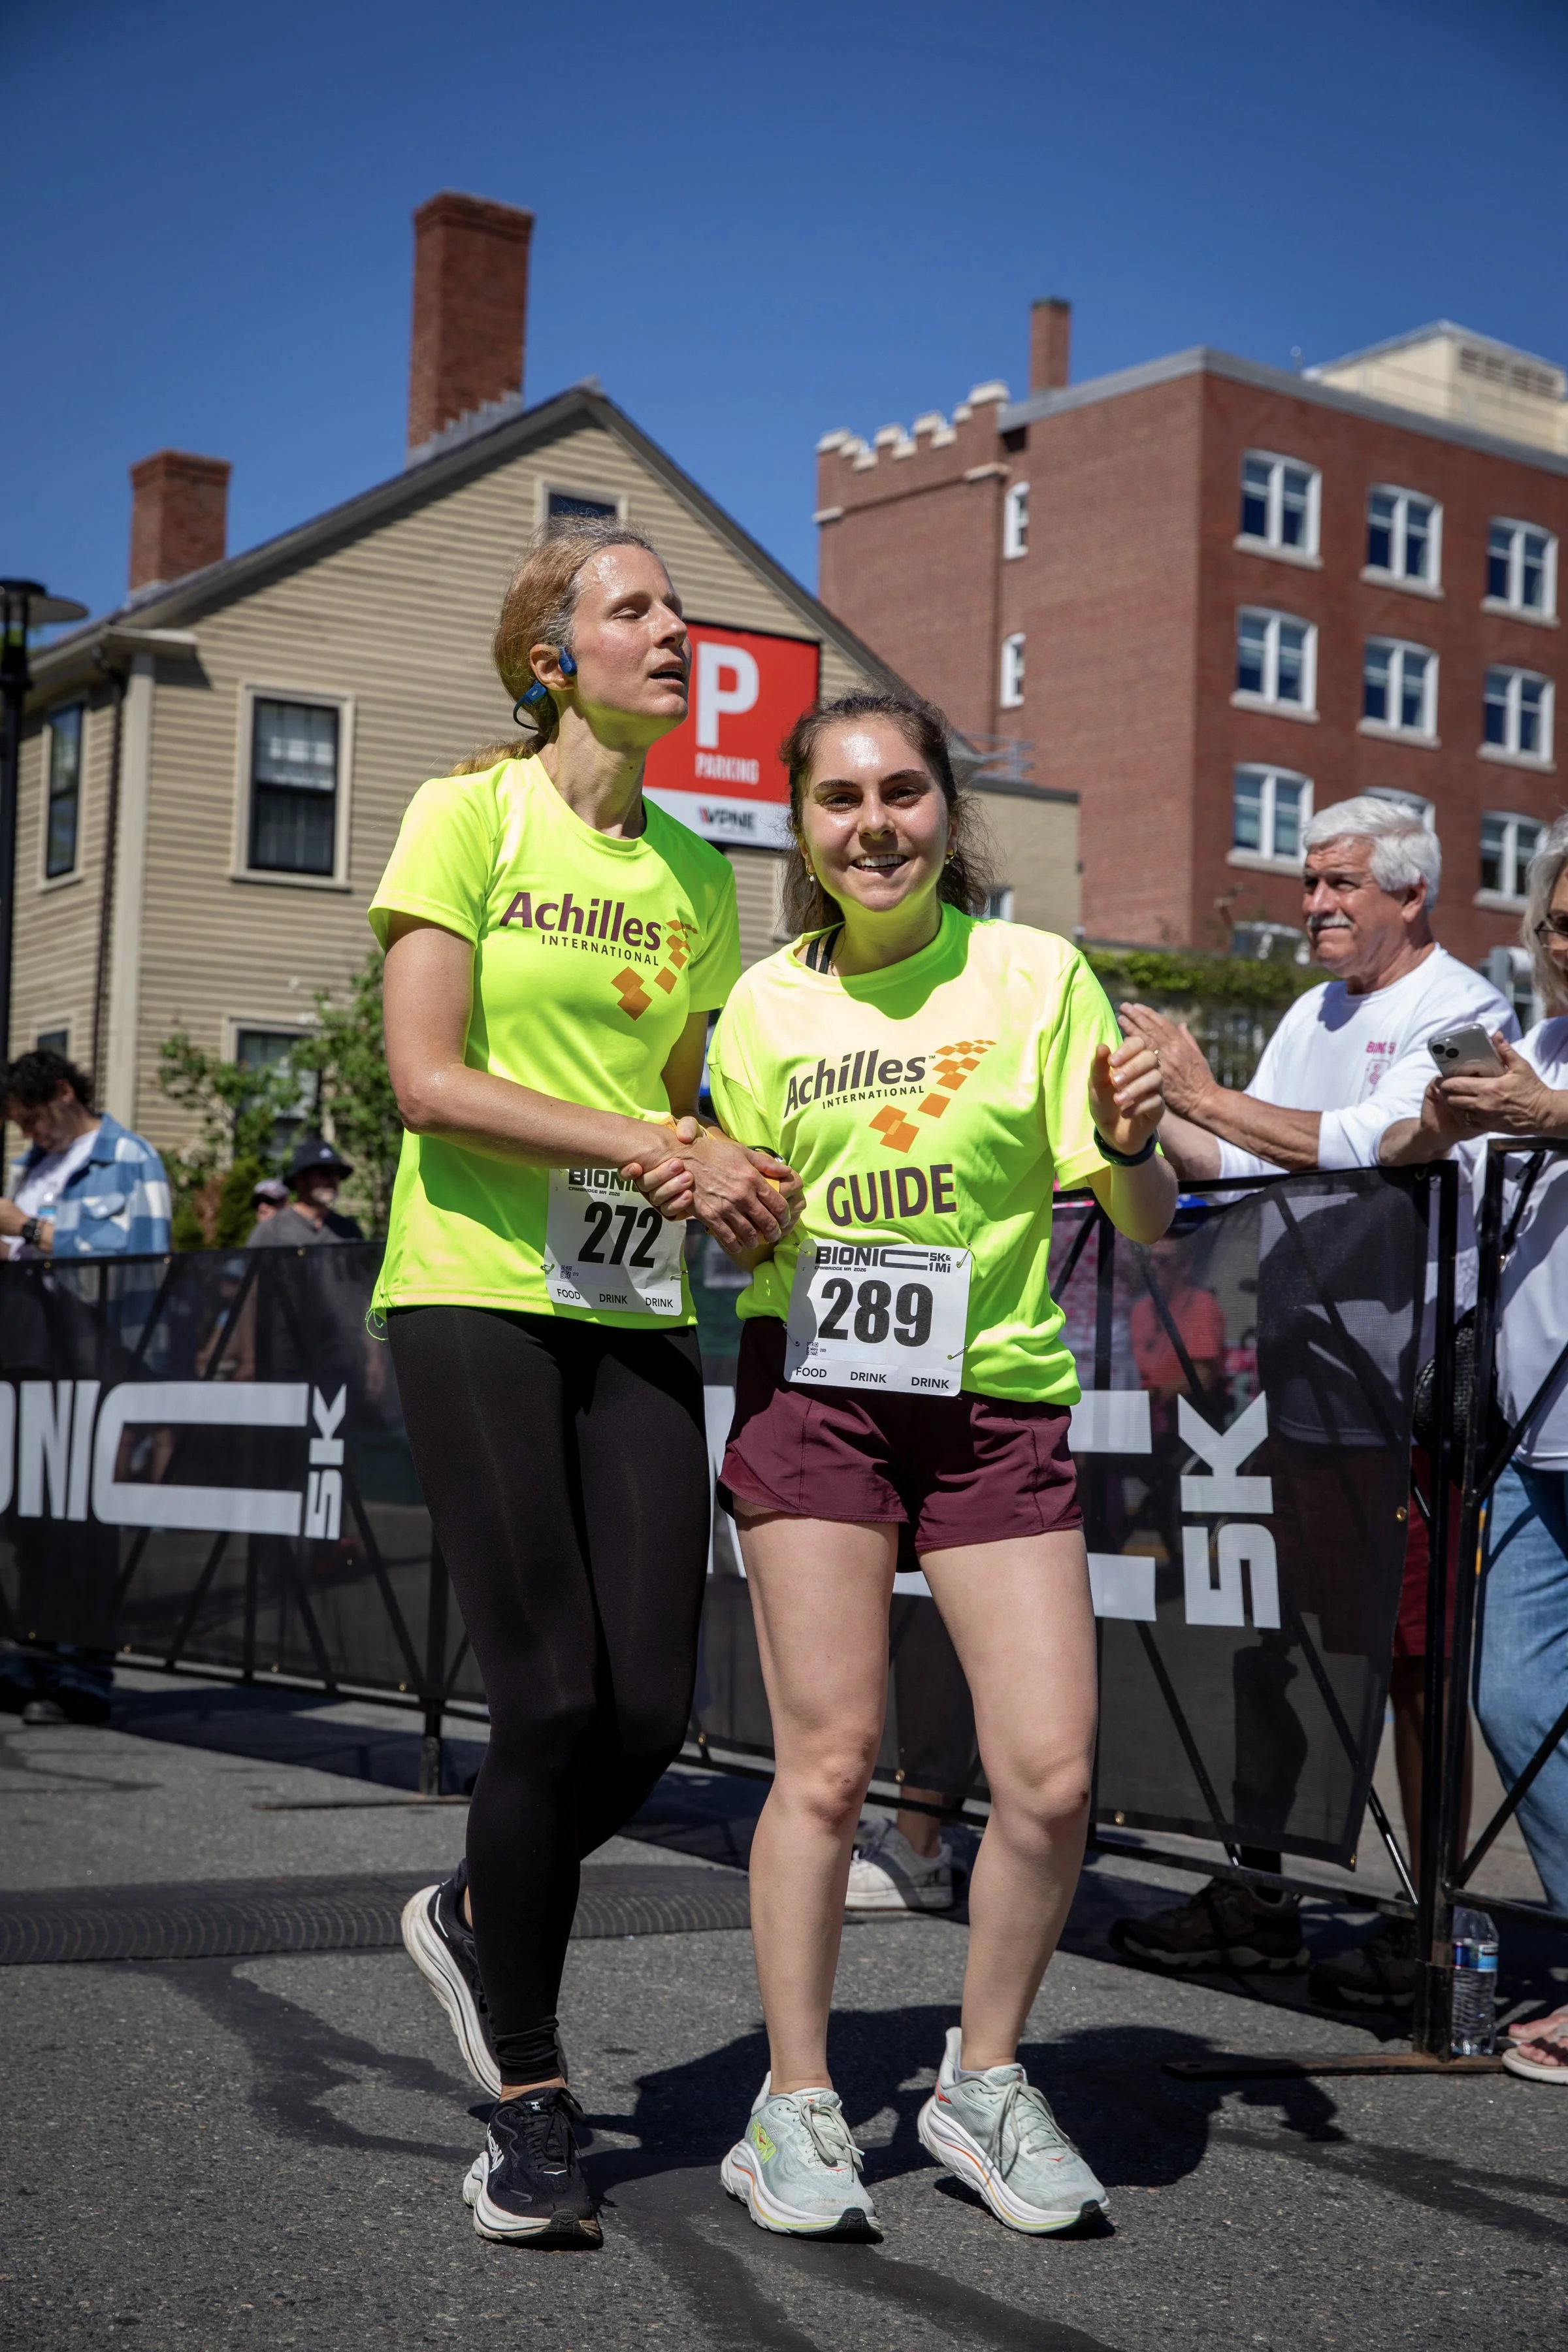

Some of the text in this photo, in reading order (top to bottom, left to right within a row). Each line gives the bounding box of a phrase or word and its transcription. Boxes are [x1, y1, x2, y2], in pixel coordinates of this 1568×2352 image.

[696, 641, 760, 749] P
[694, 752, 760, 785] PARKING
[499, 891, 662, 951] Achilles
[542, 934, 659, 966] INTERNATIONAL
[783, 1049, 926, 1119] Achilles
[822, 1085, 924, 1109] INTERNATIONAL
[568, 1169, 640, 1192] BIONI
[826, 1164, 958, 1227] GUIDE
[578, 1201, 663, 1269] 272
[815, 1246, 929, 1271] BIONIC
[557, 1288, 674, 1308] FOOD DRINK DRINK
[817, 1277, 934, 1347] 289
[796, 1367, 950, 1389] FOOD DRINK DRINK
[304, 1383, 347, 1541] 5K
[1177, 1390, 1281, 1629] 5K
